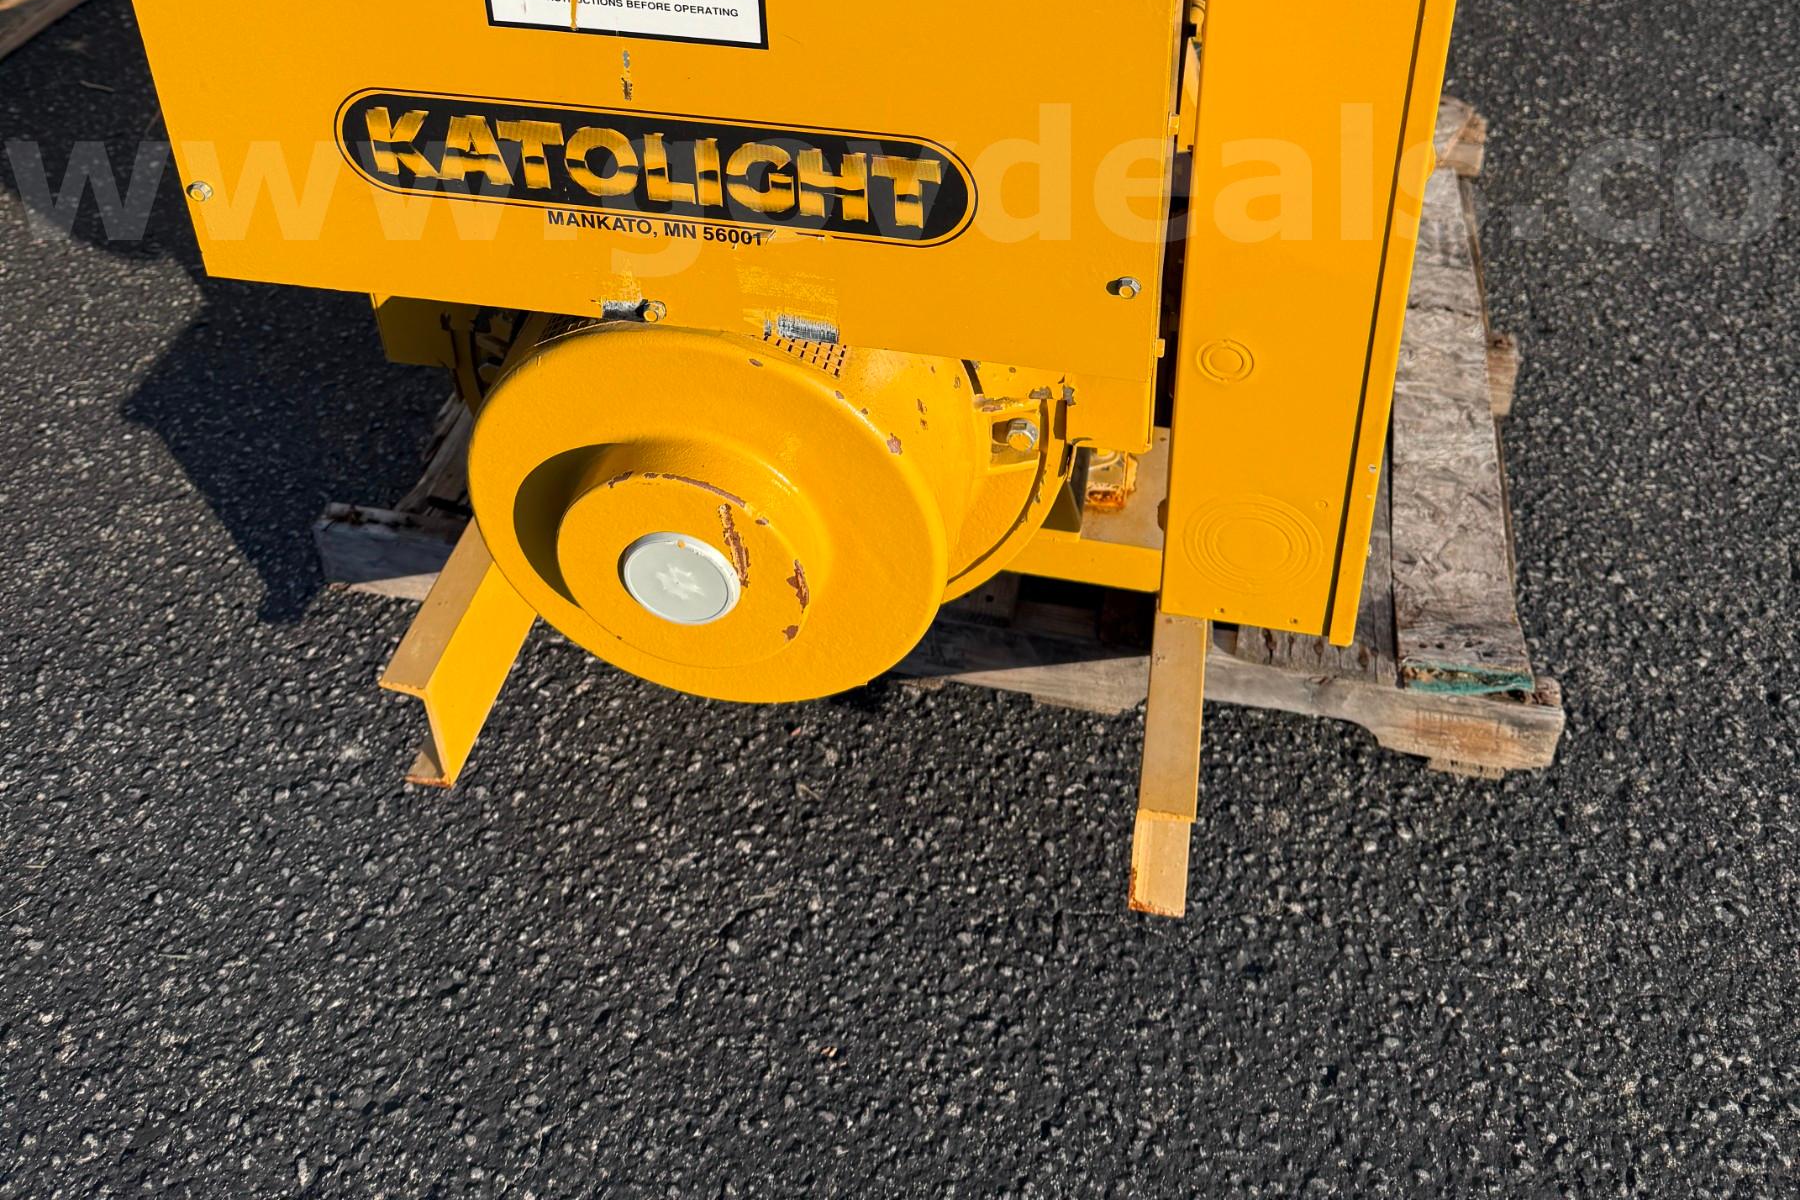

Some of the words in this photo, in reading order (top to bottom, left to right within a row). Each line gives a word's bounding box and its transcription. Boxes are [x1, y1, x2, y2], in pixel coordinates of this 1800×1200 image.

[626, 0, 671, 12] BEFORE
[674, 3, 739, 17] OPERATING
[364, 106, 943, 229] KATOLIGHT
[548, 210, 658, 238] MANKATO,
[664, 221, 697, 240] MN
[703, 226, 763, 247] 56001
